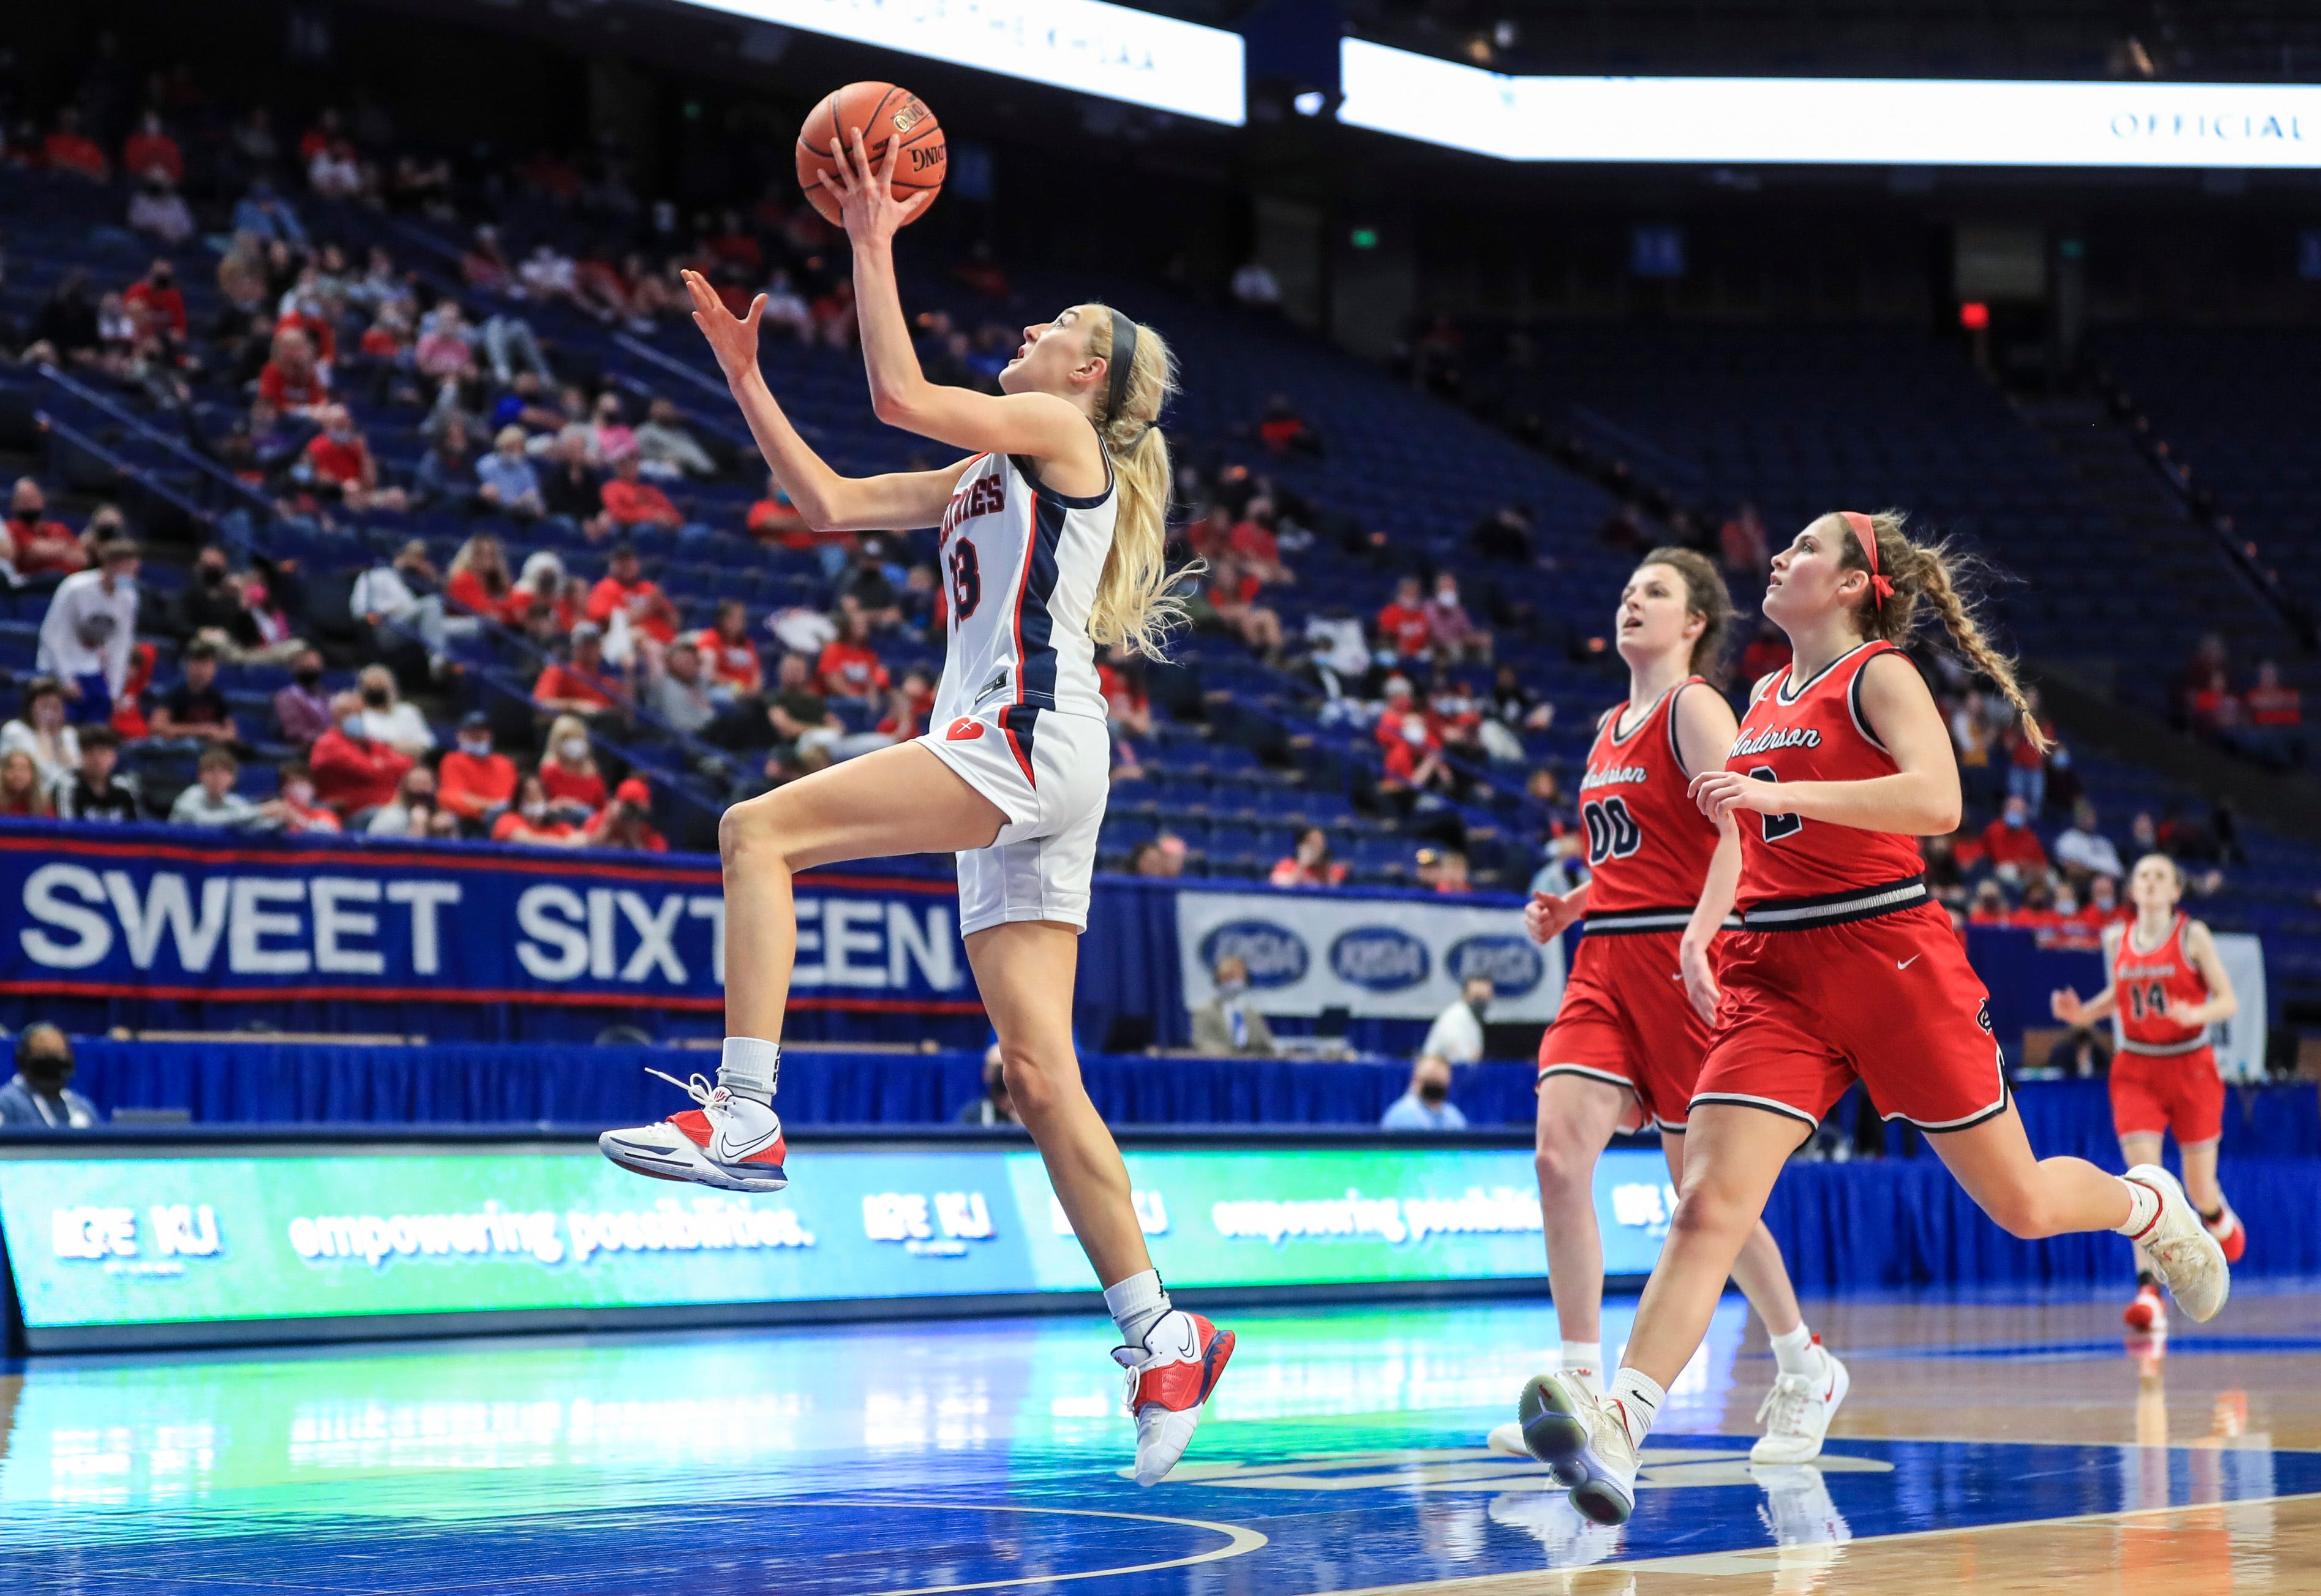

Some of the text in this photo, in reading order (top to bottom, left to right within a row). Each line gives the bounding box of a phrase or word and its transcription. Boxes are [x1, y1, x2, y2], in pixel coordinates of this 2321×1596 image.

[2111, 113, 2304, 141] OFFICIAL
[911, 143, 945, 172] DING
[1726, 723, 1823, 761] Anderson
[1583, 796, 1641, 867] 00
[20, 862, 463, 975] SWEET
[2130, 982, 2168, 1022] 14
